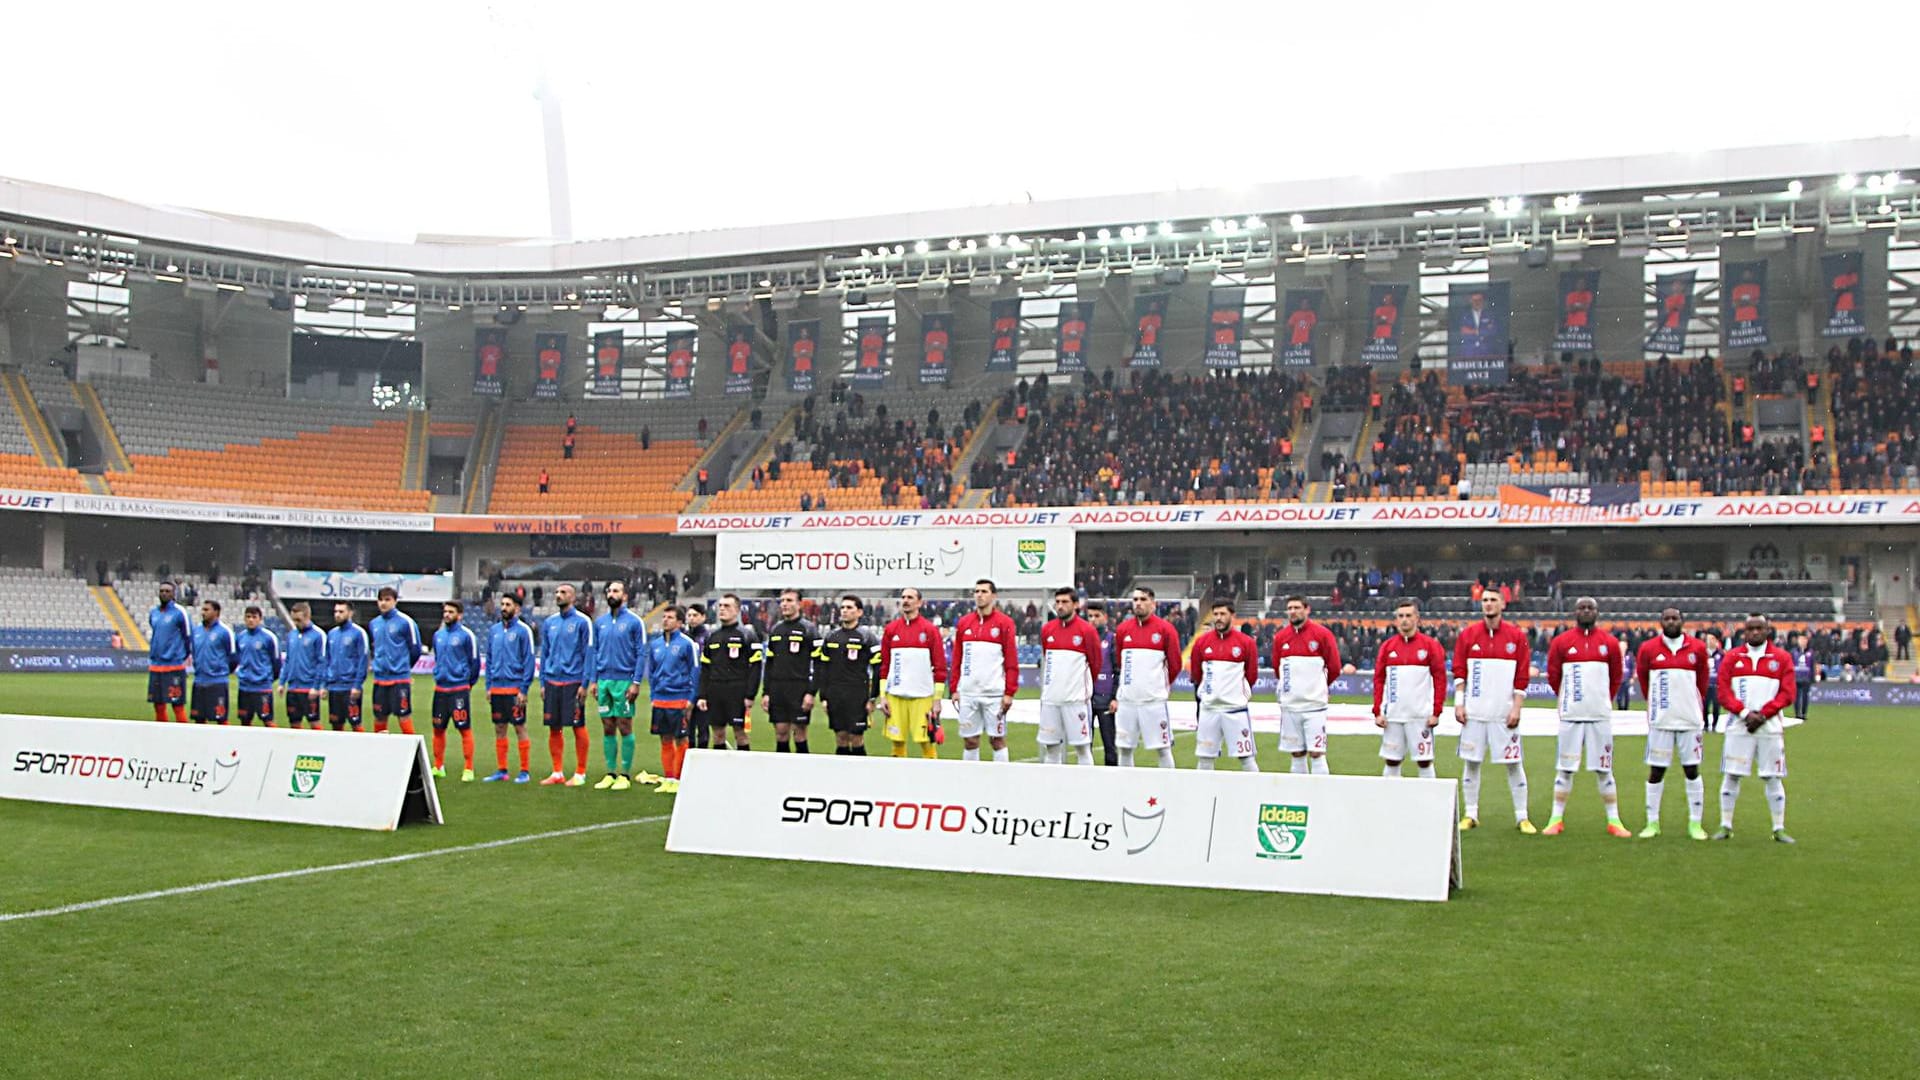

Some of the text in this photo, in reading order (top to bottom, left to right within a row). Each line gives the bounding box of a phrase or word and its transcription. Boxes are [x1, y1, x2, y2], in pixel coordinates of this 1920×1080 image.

[1716, 500, 1888, 516] ANADOLUJET
[802, 514, 922, 528] ANADOLUJET
[932, 512, 1060, 526] ANADOLUJET
[1068, 510, 1204, 524] ANADOLUJET
[1215, 508, 1361, 523] ANADOLUJET
[493, 519, 623, 533] www.ibfk.com.tr
[680, 516, 792, 530] ANADOLUJET
[739, 551, 935, 576] SPORTOTO SüperLig
[1236, 740, 1252, 754] 30
[1504, 746, 1520, 760] 22
[14, 750, 208, 793] SPORTOTO SüperLig
[1261, 805, 1307, 824] iddaa
[781, 796, 1113, 852] SPORTOTO SüperLig
